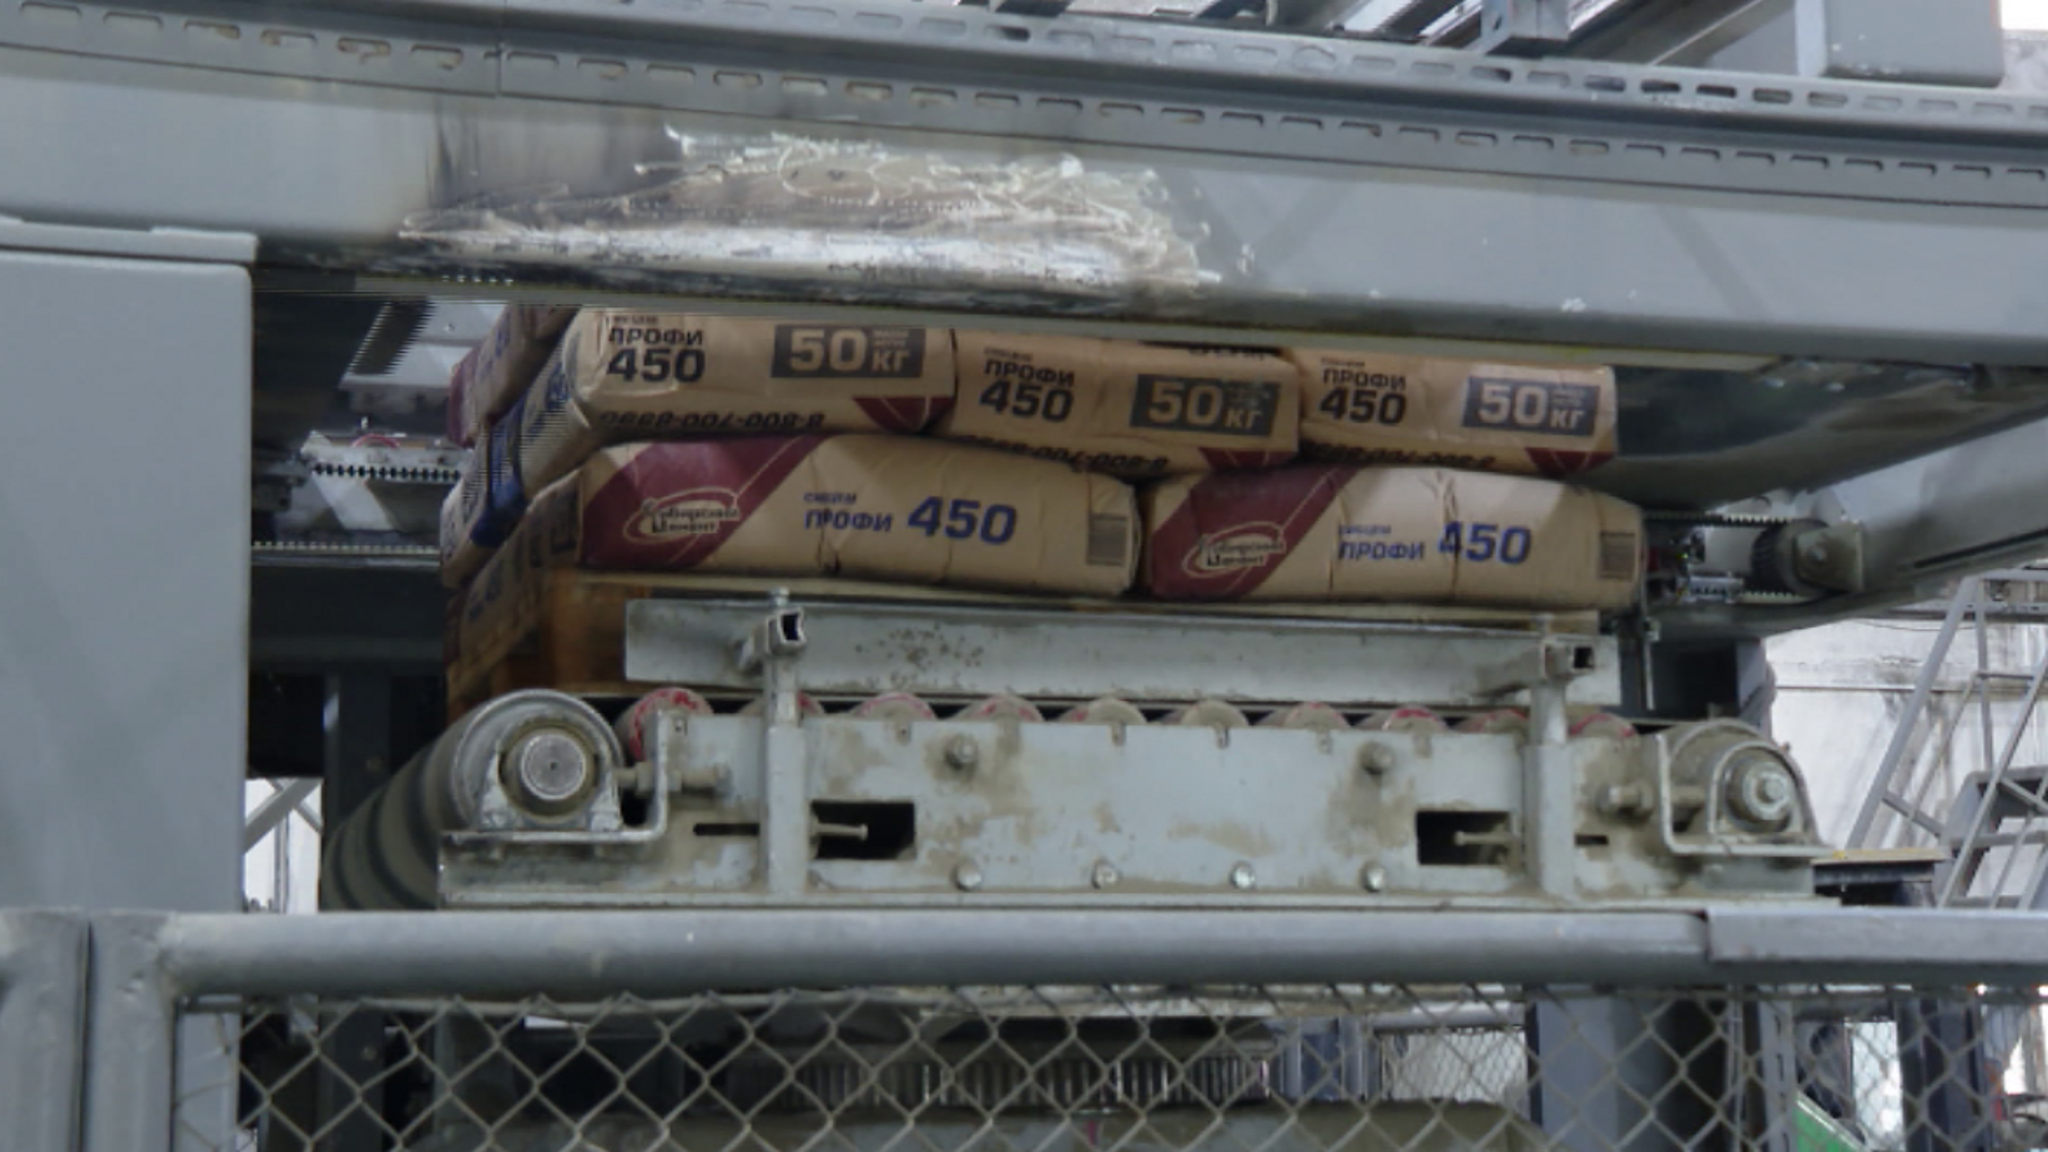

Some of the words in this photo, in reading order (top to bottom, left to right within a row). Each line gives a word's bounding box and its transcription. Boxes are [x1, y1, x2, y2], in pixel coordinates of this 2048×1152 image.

[608, 327, 704, 345] ПРОФИ
[790, 327, 867, 372] 50
[606, 348, 706, 383] 450
[984, 359, 1075, 388] ПРОФИ
[1322, 368, 1407, 391] ПРОФИ
[978, 380, 1075, 423] 450
[1149, 380, 1224, 427] 50
[1319, 386, 1407, 426] 450
[1479, 381, 1547, 425] 50
[804, 508, 893, 532] ПРОФИ
[907, 496, 1017, 545] 450
[1338, 541, 1425, 561] ПРОФИ
[1438, 521, 1531, 565] 450
